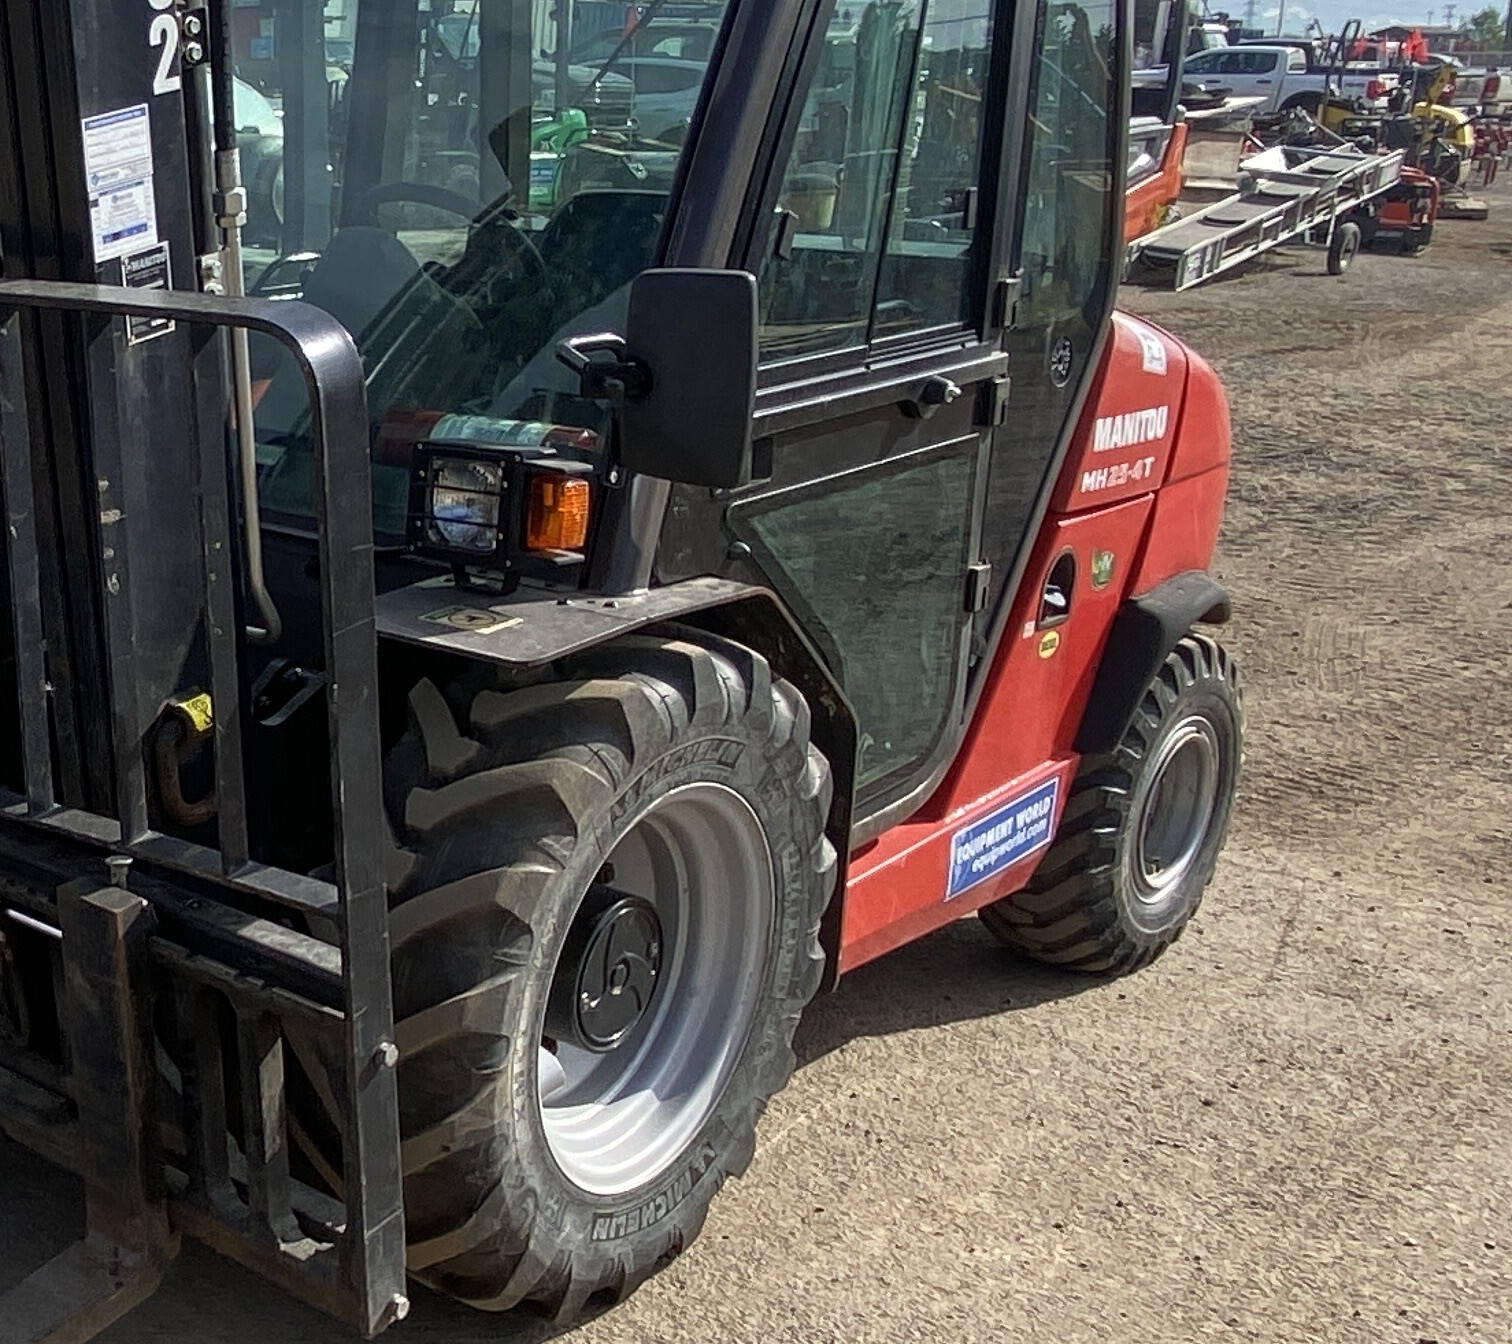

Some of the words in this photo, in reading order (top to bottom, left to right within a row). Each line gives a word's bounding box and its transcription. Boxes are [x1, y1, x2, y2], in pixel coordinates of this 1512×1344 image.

[1093, 405, 1169, 453] MANITOU
[956, 816, 1014, 865] EQUIPMENT
[1016, 796, 1051, 830] WORLD
[592, 1170, 693, 1241] MICHELIN
